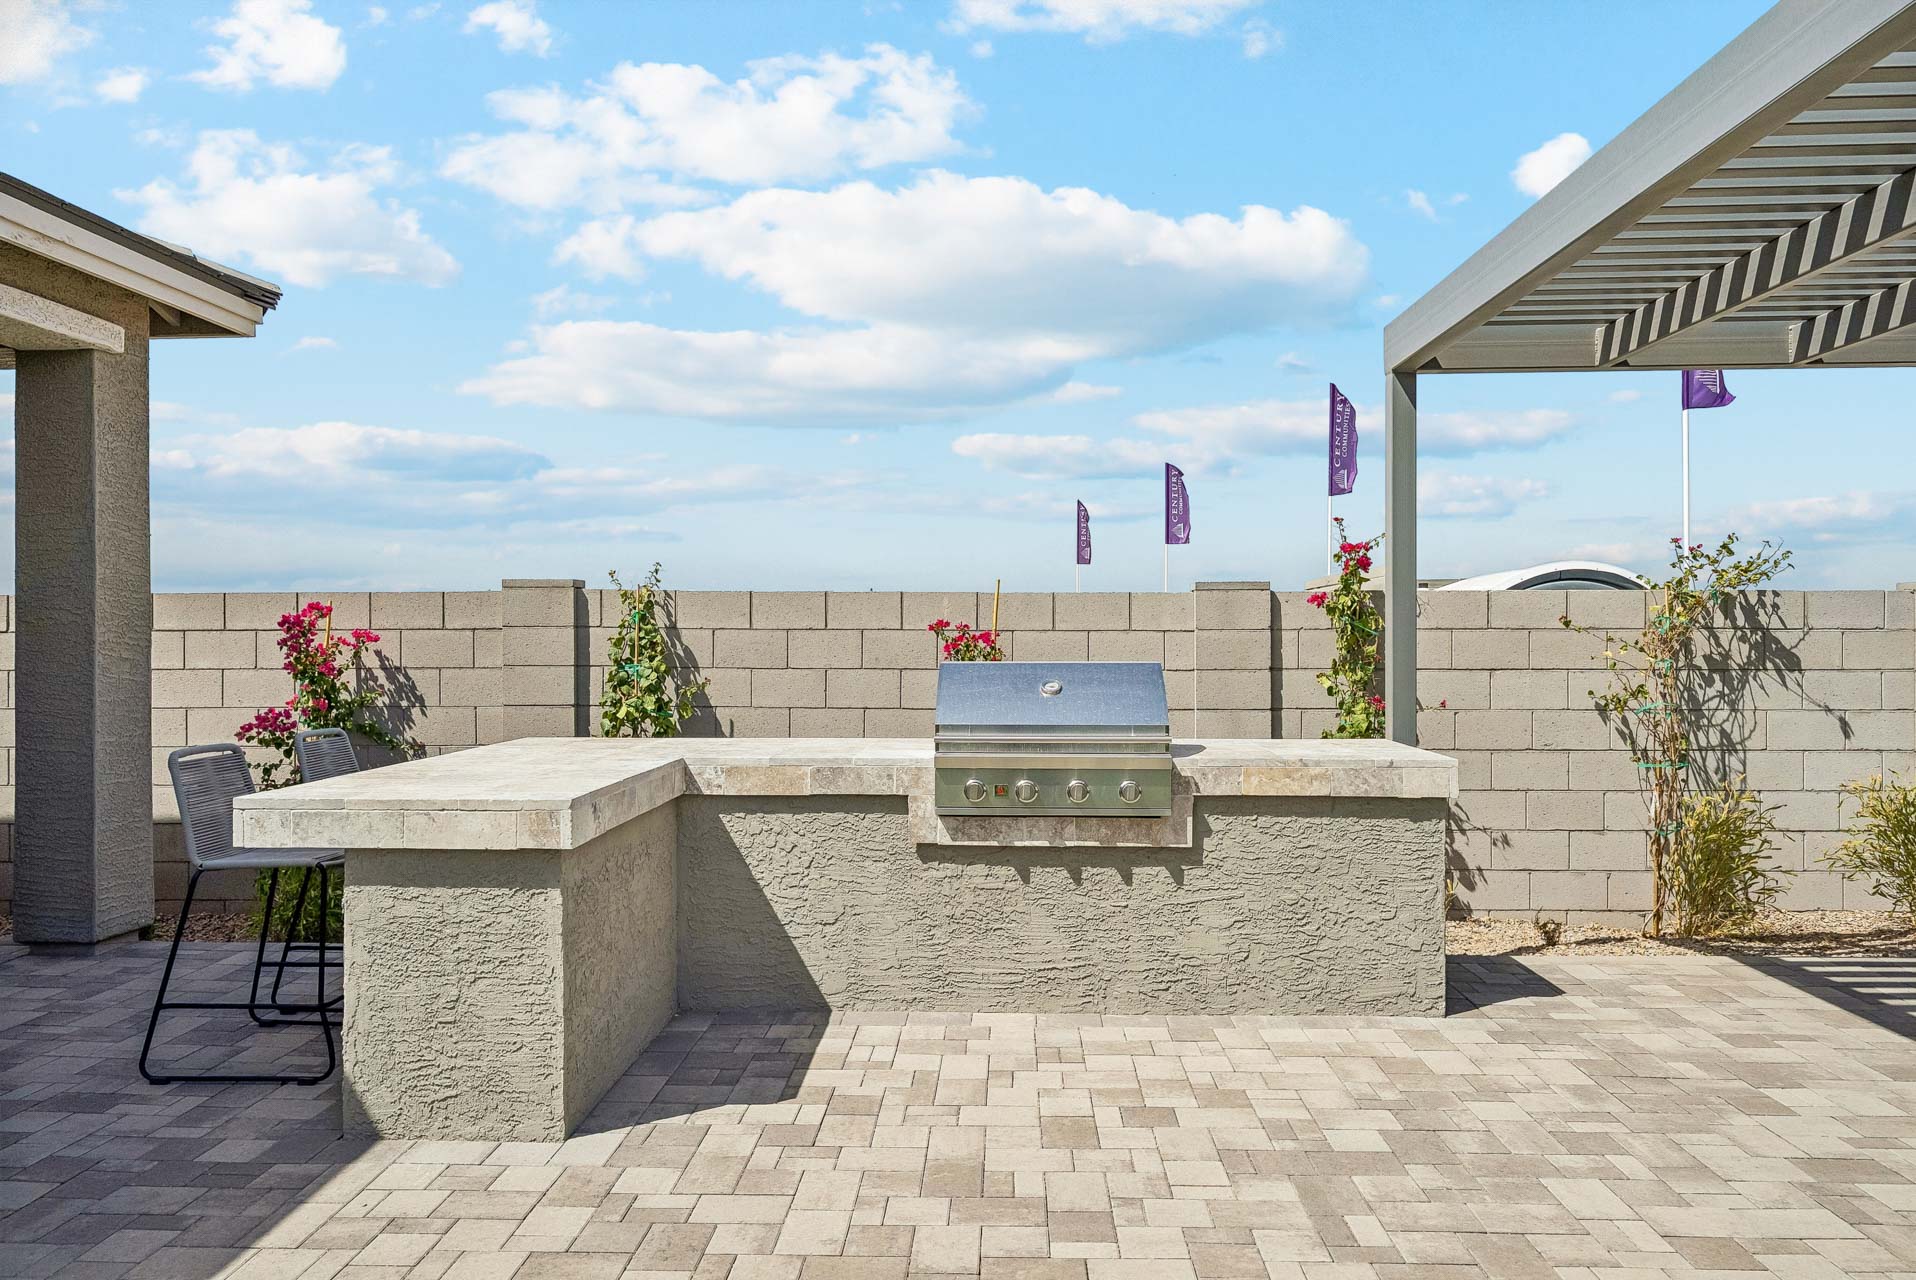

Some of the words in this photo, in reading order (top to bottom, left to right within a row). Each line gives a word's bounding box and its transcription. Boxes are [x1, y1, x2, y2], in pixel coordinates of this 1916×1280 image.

[1334, 393, 1345, 467] CENTURY
[1341, 403, 1351, 457] COMMUNITIES
[1171, 469, 1179, 522] CENTURY
